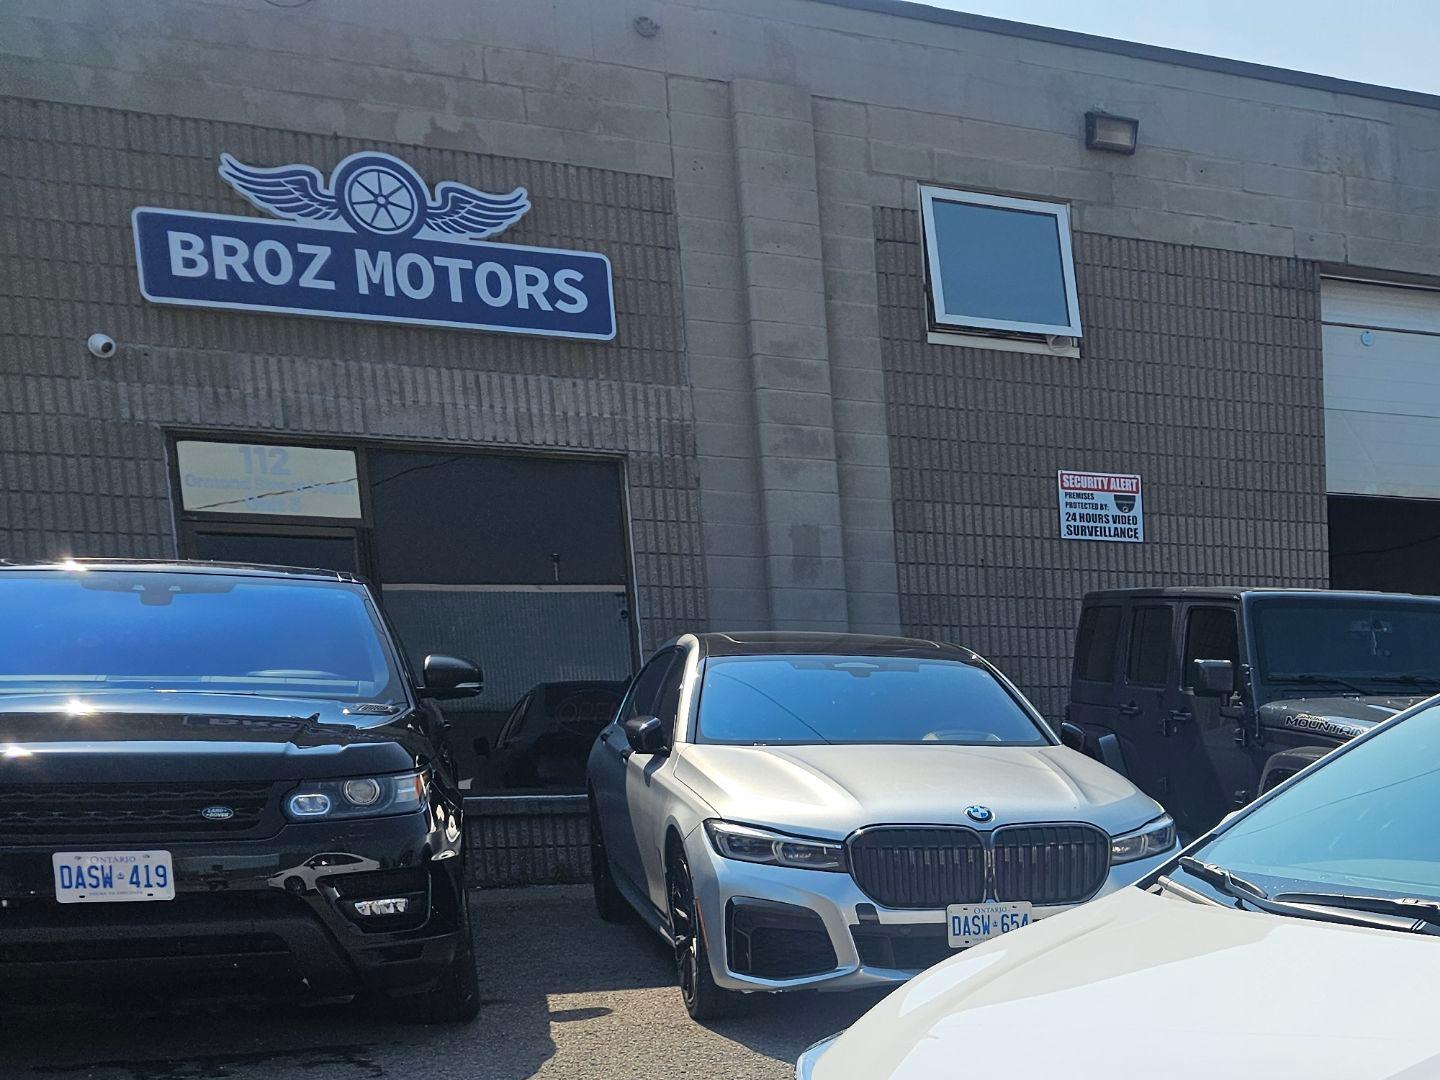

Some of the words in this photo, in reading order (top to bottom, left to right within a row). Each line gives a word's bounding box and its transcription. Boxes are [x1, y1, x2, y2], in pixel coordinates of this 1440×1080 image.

[166, 230, 336, 290] BROZ
[355, 248, 589, 313] MOTORS
[238, 446, 290, 475] 112
[1062, 474, 1108, 490] SECURITY
[1110, 478, 1137, 492] ALERT
[1064, 492, 1095, 500] PREMISES
[1065, 502, 1098, 510] PROTECTED
[1065, 512, 1077, 522] 24
[1079, 513, 1110, 524] HOURS
[1112, 514, 1138, 525] VIDEO
[1066, 525, 1138, 539] SURVEILLANCE
[60, 865, 113, 889] DASW
[129, 864, 168, 888] 419
[952, 914, 990, 936] DASW
